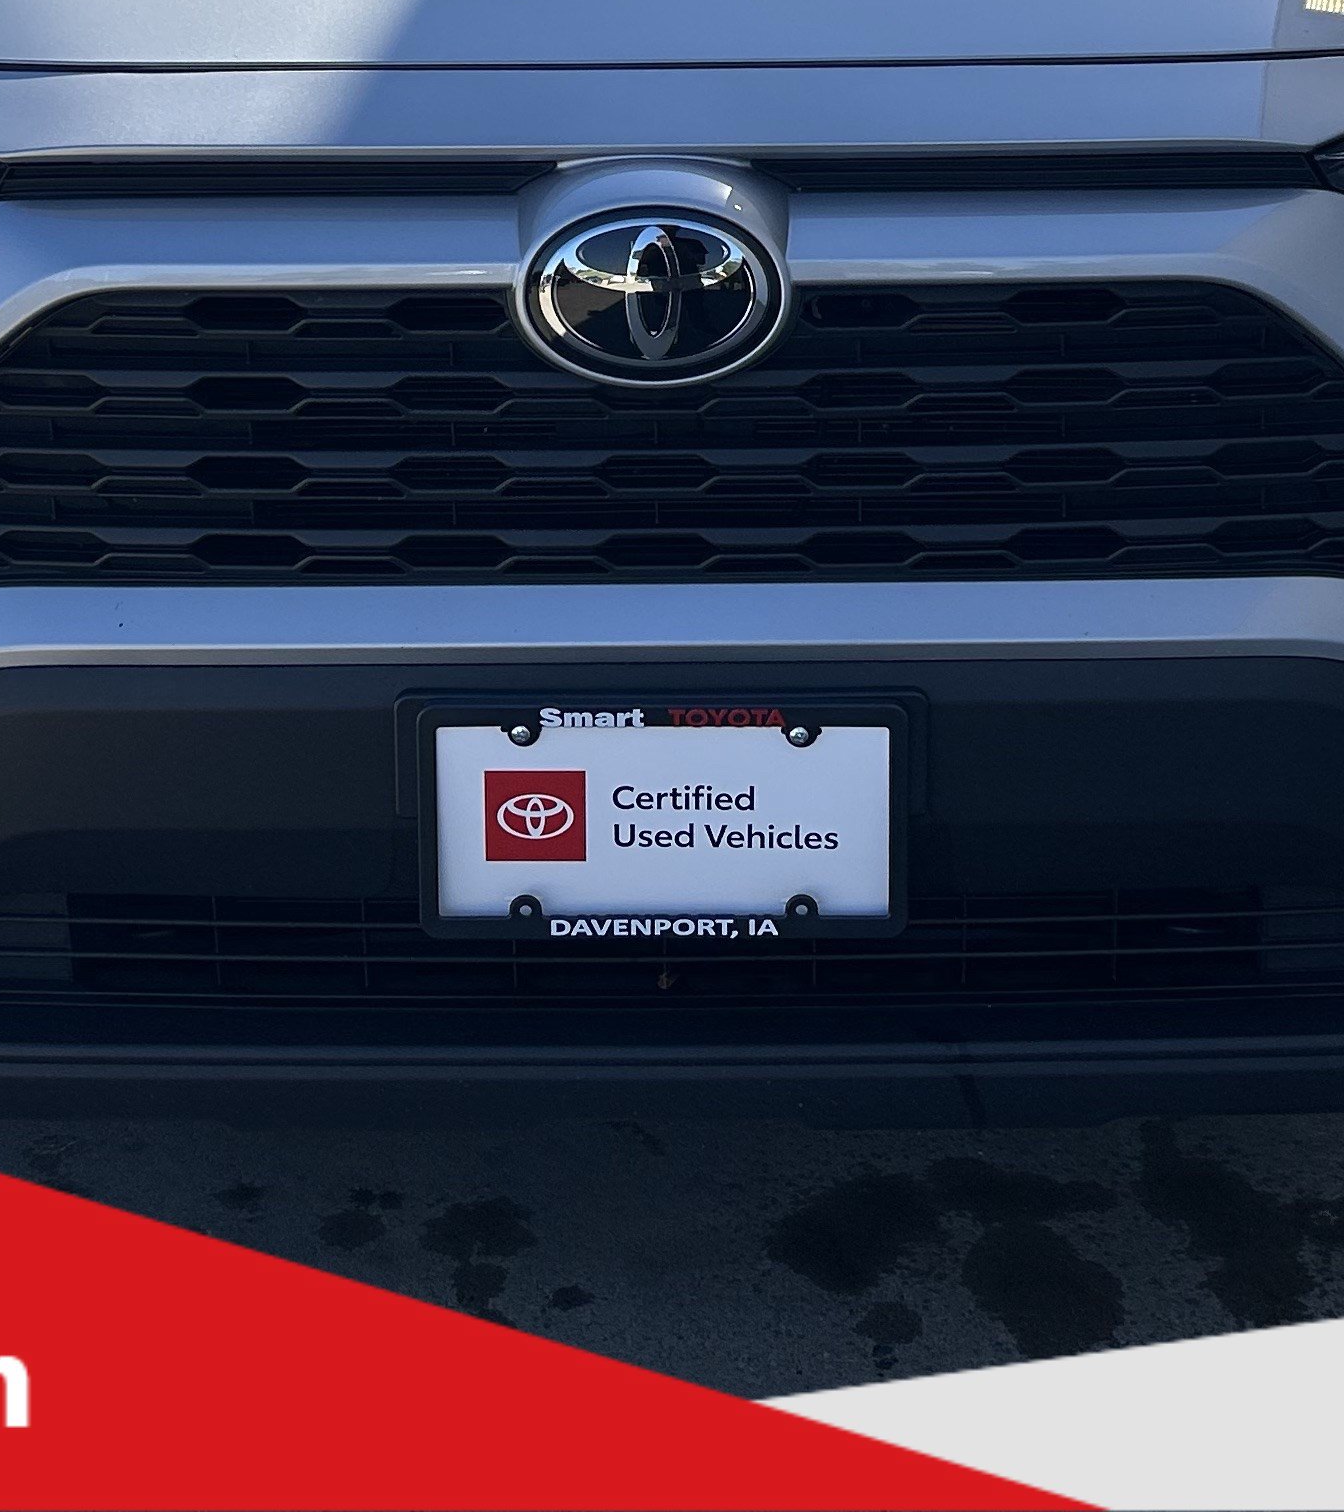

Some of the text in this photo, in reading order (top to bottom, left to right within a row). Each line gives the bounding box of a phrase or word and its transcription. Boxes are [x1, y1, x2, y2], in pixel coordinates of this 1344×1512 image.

[539, 707, 786, 729] Smart TOYOTA
[612, 785, 756, 812] Certified
[612, 823, 839, 851] Used Vehicles
[550, 918, 779, 939] DAVENPORT, IA
